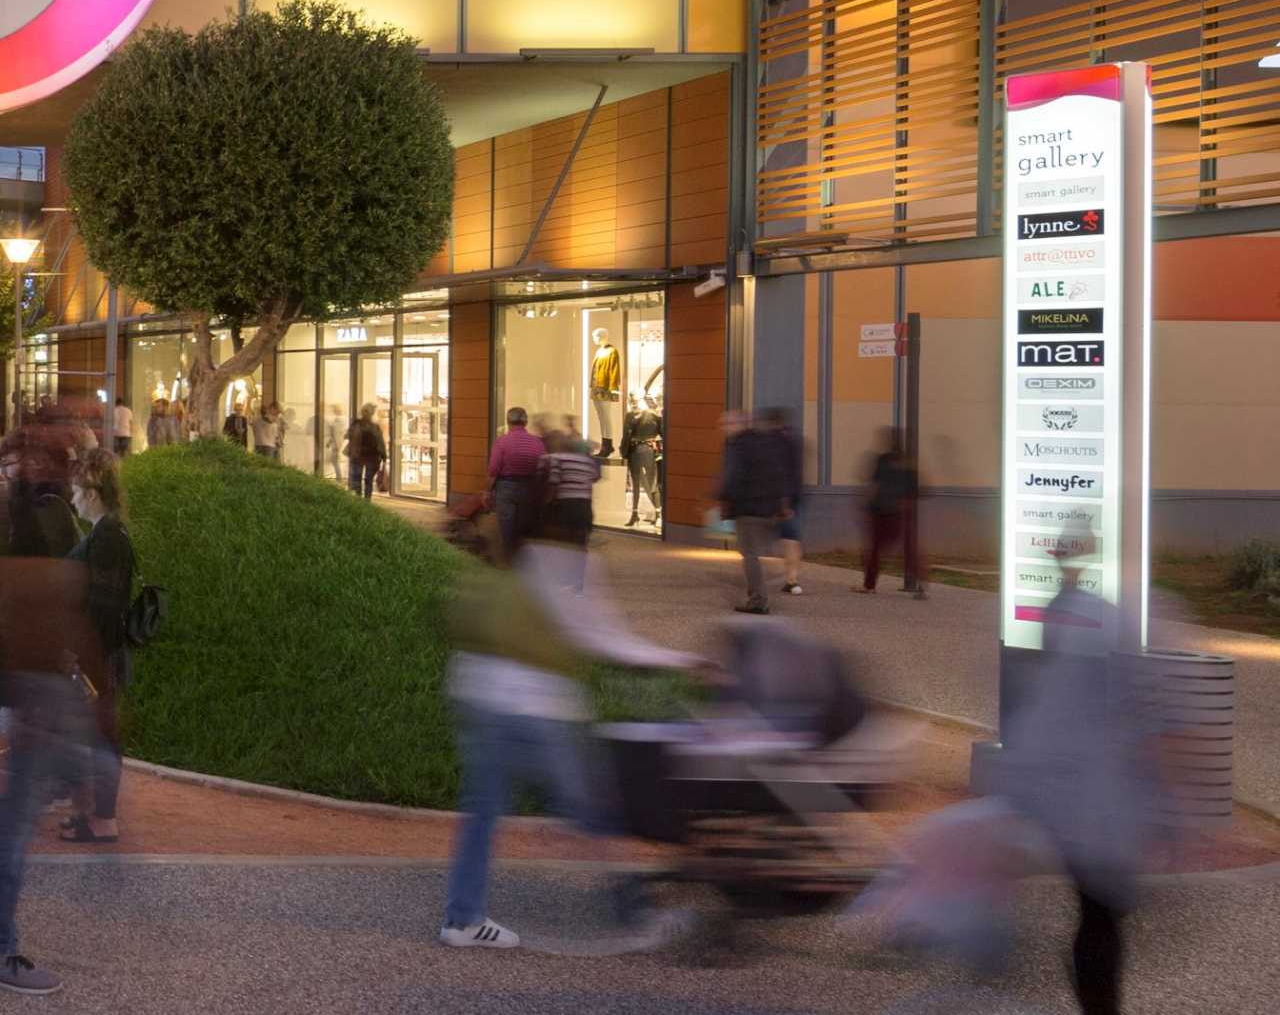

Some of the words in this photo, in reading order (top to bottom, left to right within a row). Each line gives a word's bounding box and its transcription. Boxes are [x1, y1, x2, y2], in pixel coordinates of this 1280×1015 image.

[1018, 129, 1072, 145] smart
[1018, 145, 1104, 176] gallery
[1025, 189, 1056, 199] smart
[1059, 185, 1097, 196] gallery
[1023, 217, 1080, 238] lynne
[1025, 473, 1095, 492] Jennyfer
[1023, 509, 1053, 519] smart
[1057, 510, 1095, 522] gallery
[1019, 573, 1053, 584] smart
